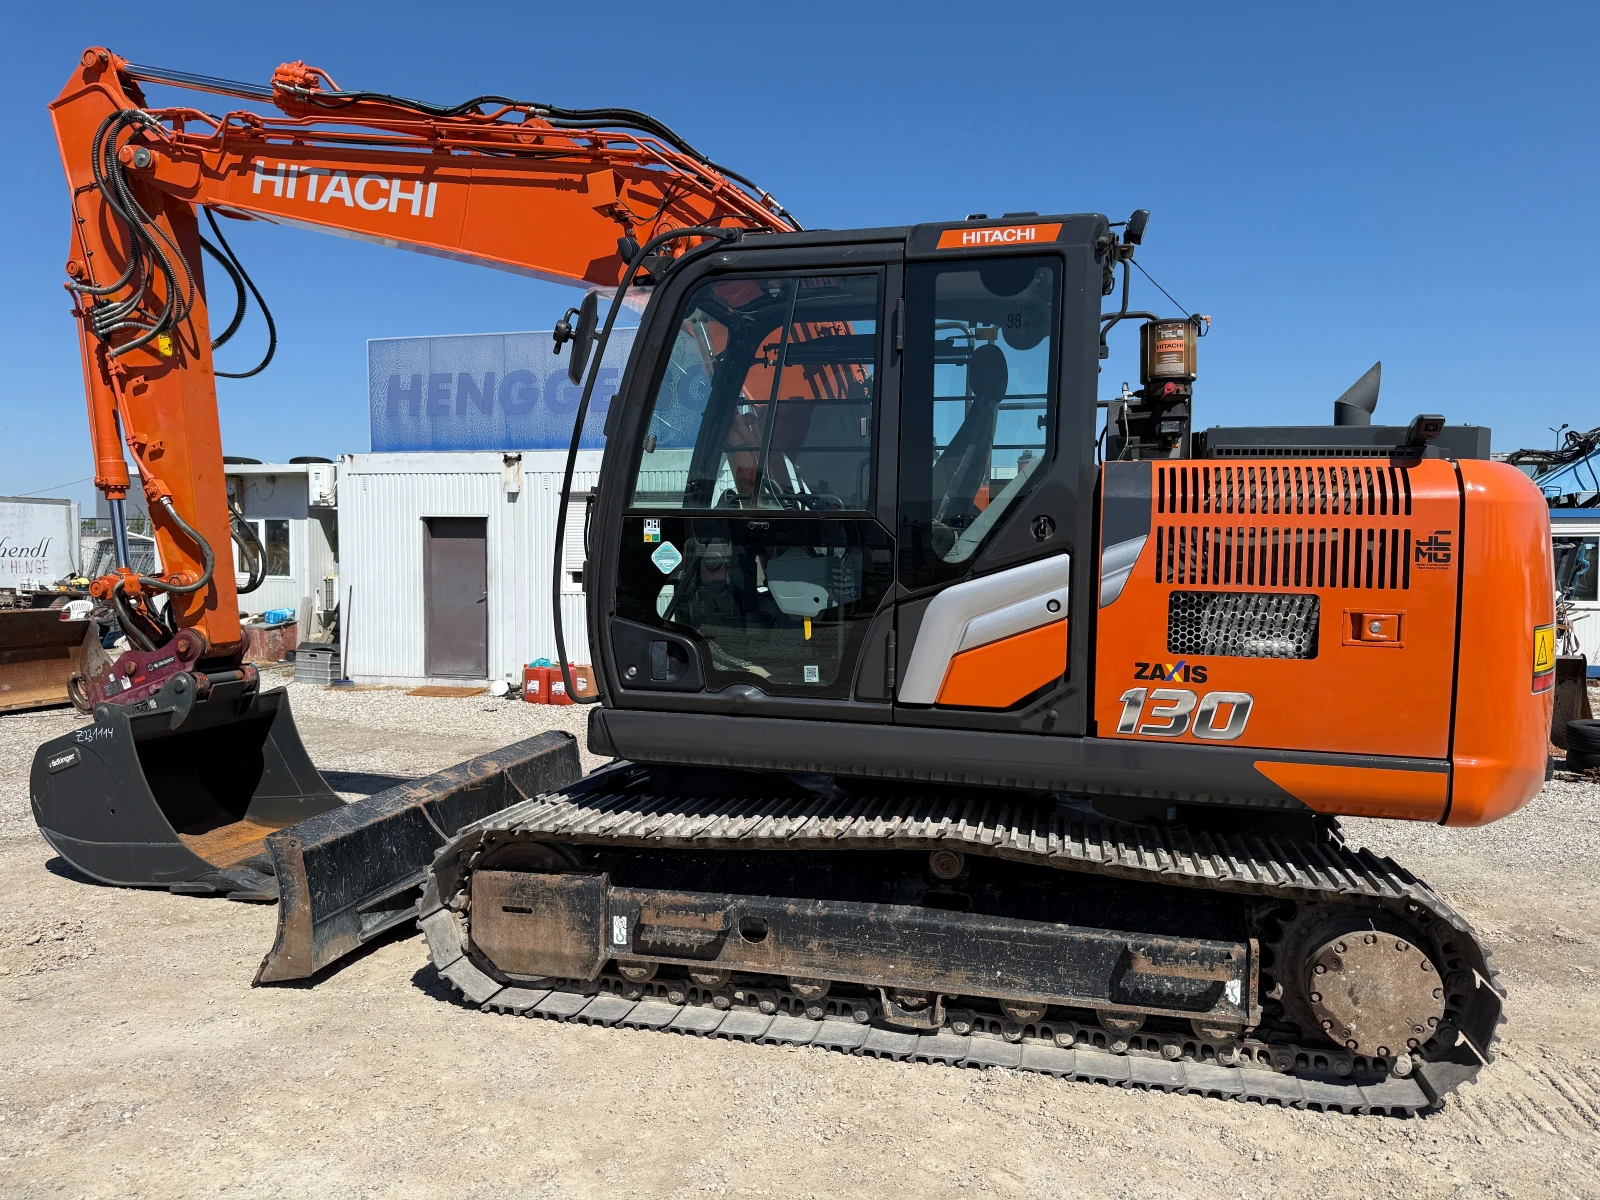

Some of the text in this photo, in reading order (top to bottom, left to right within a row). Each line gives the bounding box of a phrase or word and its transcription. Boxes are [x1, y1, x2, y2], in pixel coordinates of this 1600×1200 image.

[252, 160, 438, 218] HITACHI
[962, 227, 1036, 245] HITACHI
[1007, 313, 1021, 329] 98
[1156, 342, 1184, 350] HITACHI
[1133, 660, 1208, 684] ZAXIS
[1116, 687, 1254, 740] 130
[75, 727, 114, 742] Z231114
